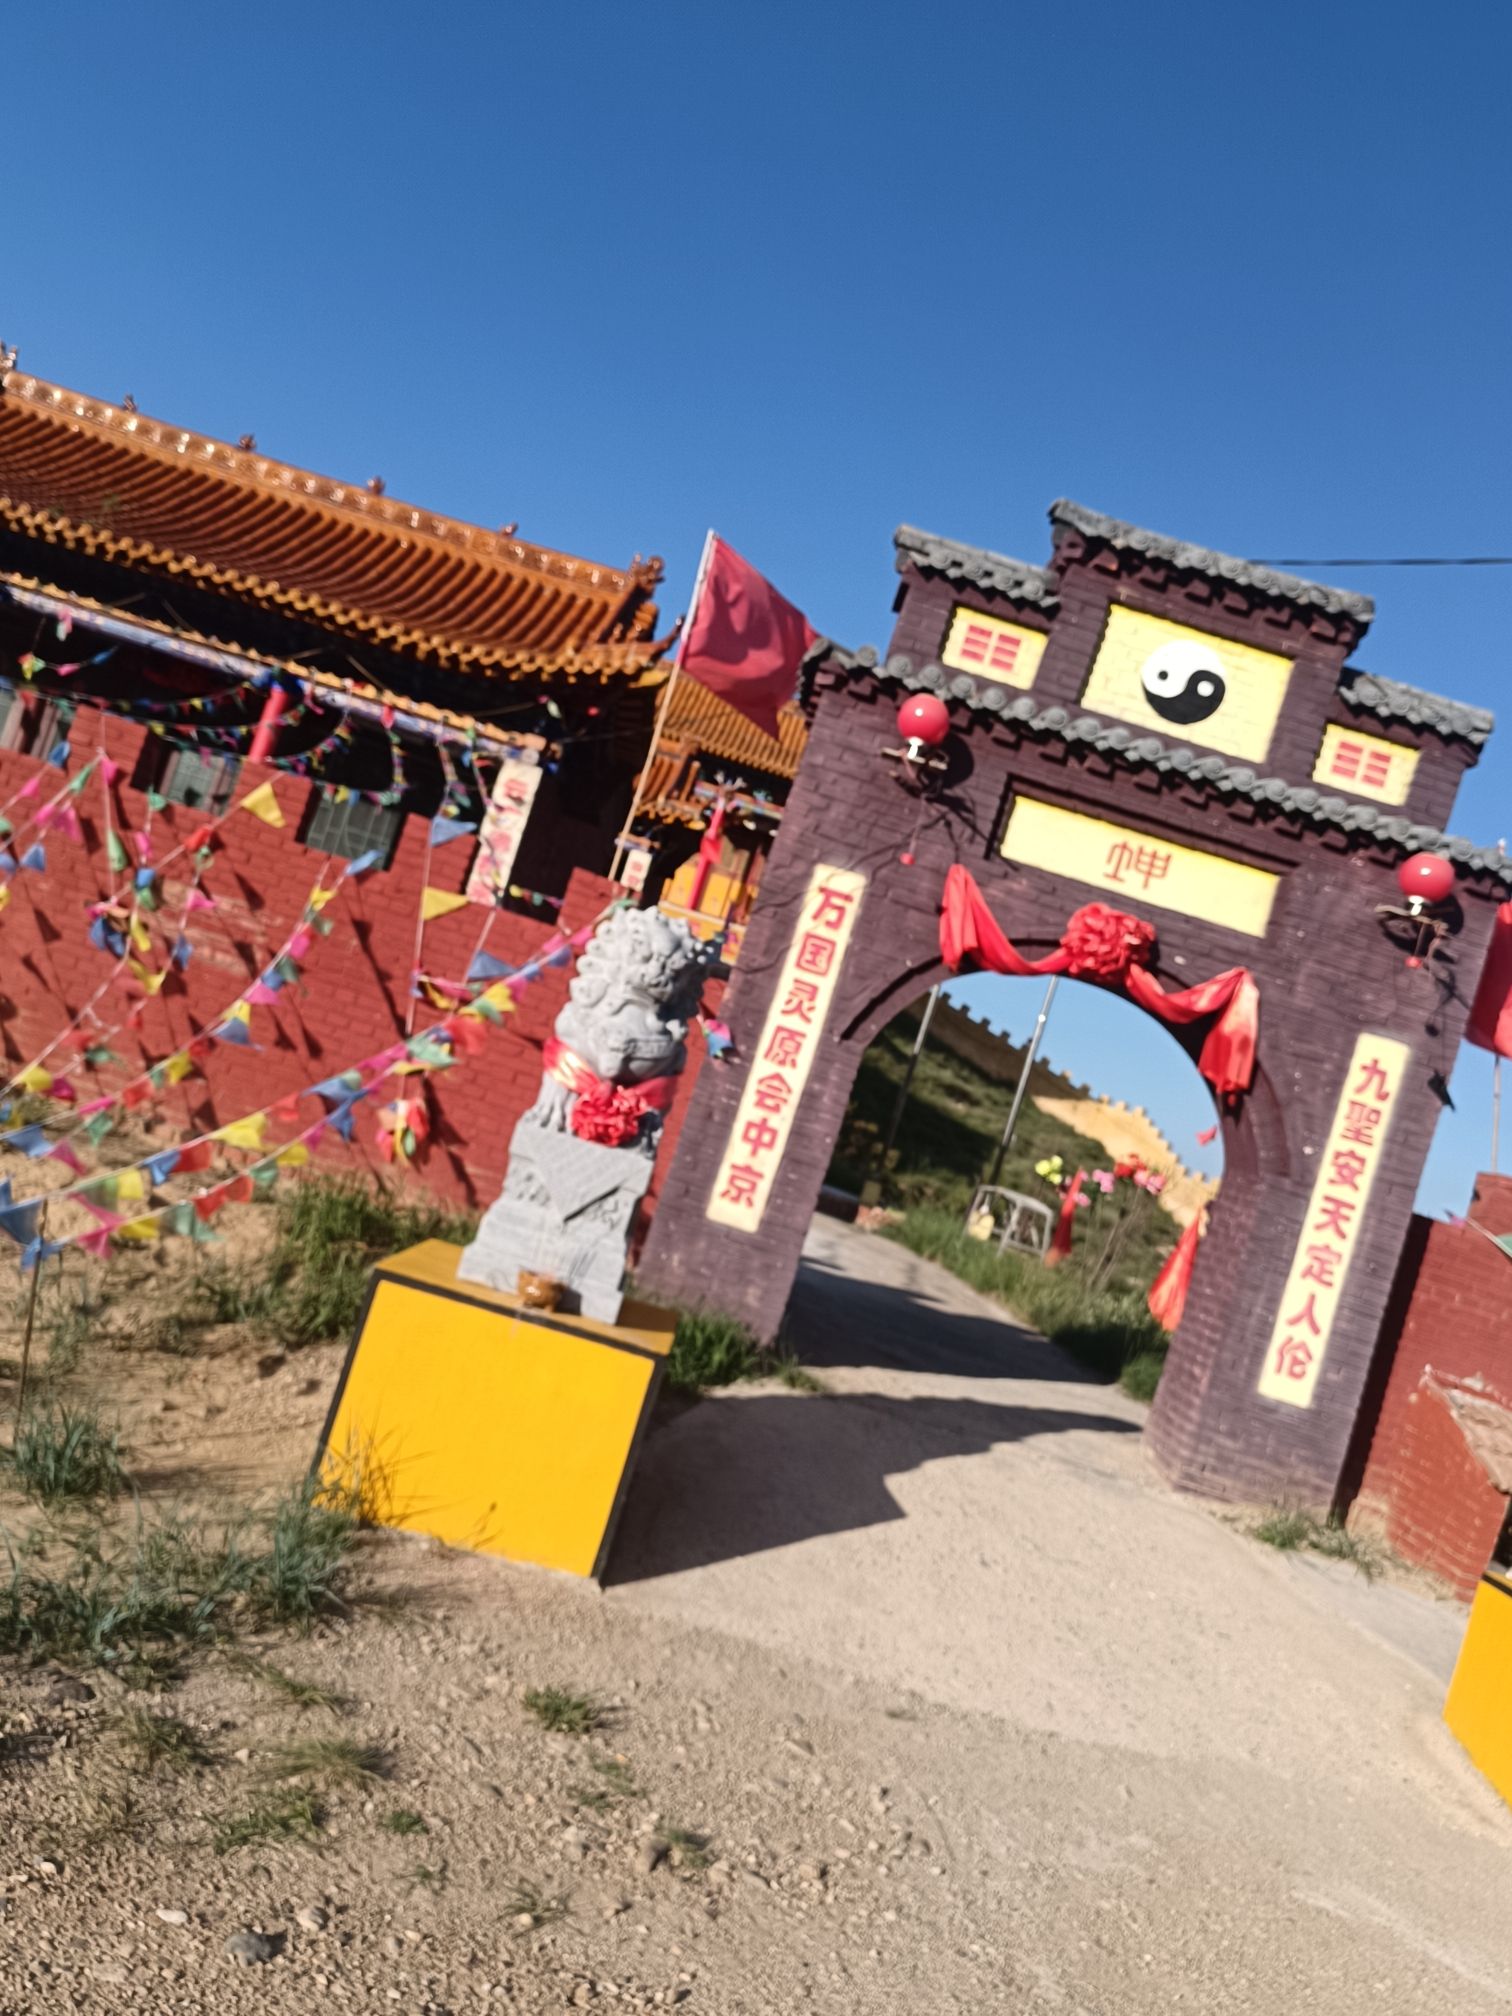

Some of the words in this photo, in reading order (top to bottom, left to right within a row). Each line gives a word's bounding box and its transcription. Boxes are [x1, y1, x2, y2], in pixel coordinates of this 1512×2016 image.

[720, 886, 853, 1208] 万国灵原会中京
[1274, 1058, 1390, 1381] 九聖安天定人伦
